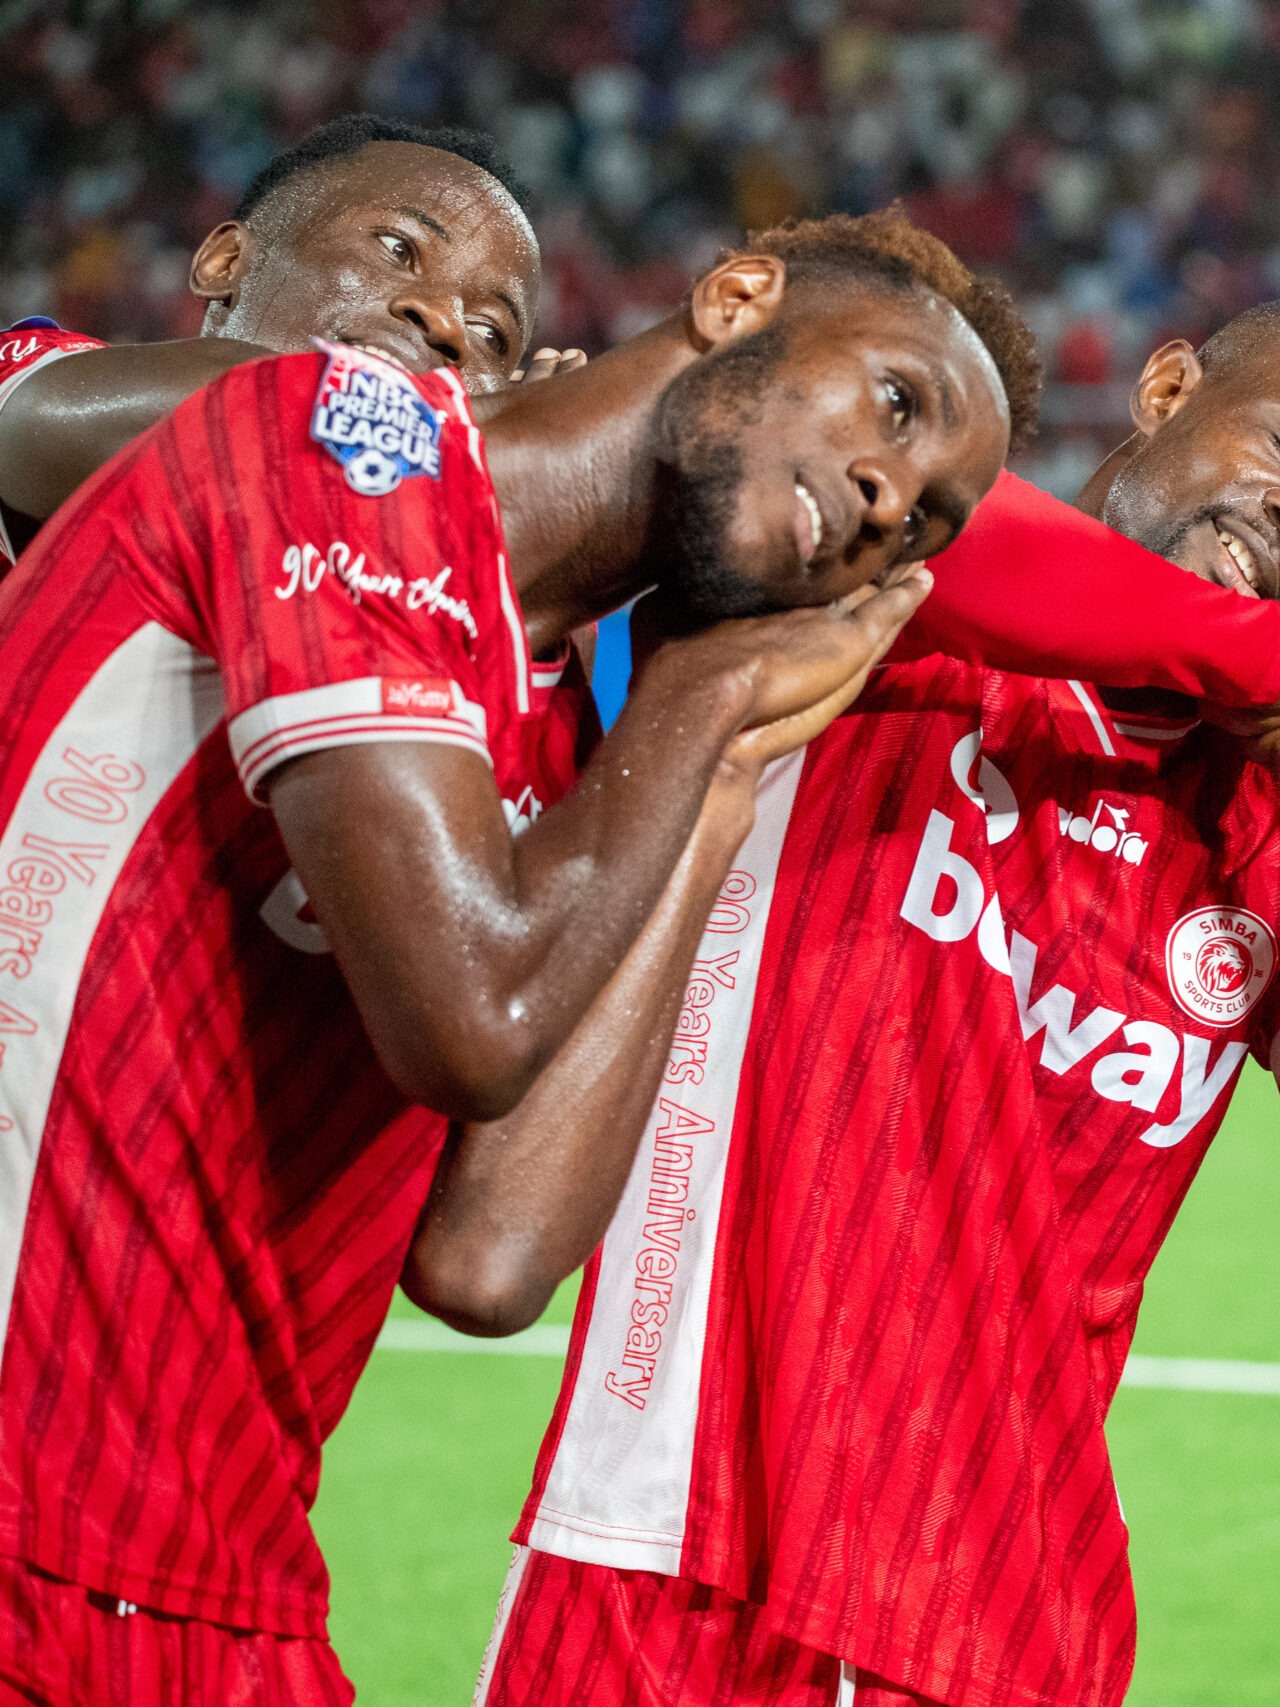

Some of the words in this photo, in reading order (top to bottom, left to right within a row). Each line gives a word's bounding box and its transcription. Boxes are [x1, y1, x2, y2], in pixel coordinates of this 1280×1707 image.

[315, 406, 441, 475] LEAGUE
[328, 392, 434, 440] PREMIER
[274, 542, 327, 600] 90
[44, 746, 147, 826] 90
[1182, 952, 1192, 961] 19
[1199, 917, 1258, 946] SIMBA
[662, 949, 740, 1086] Years
[1184, 980, 1223, 1014] SPORTS
[1226, 993, 1252, 1013] CLUB
[605, 1097, 716, 1411] Anniversary
